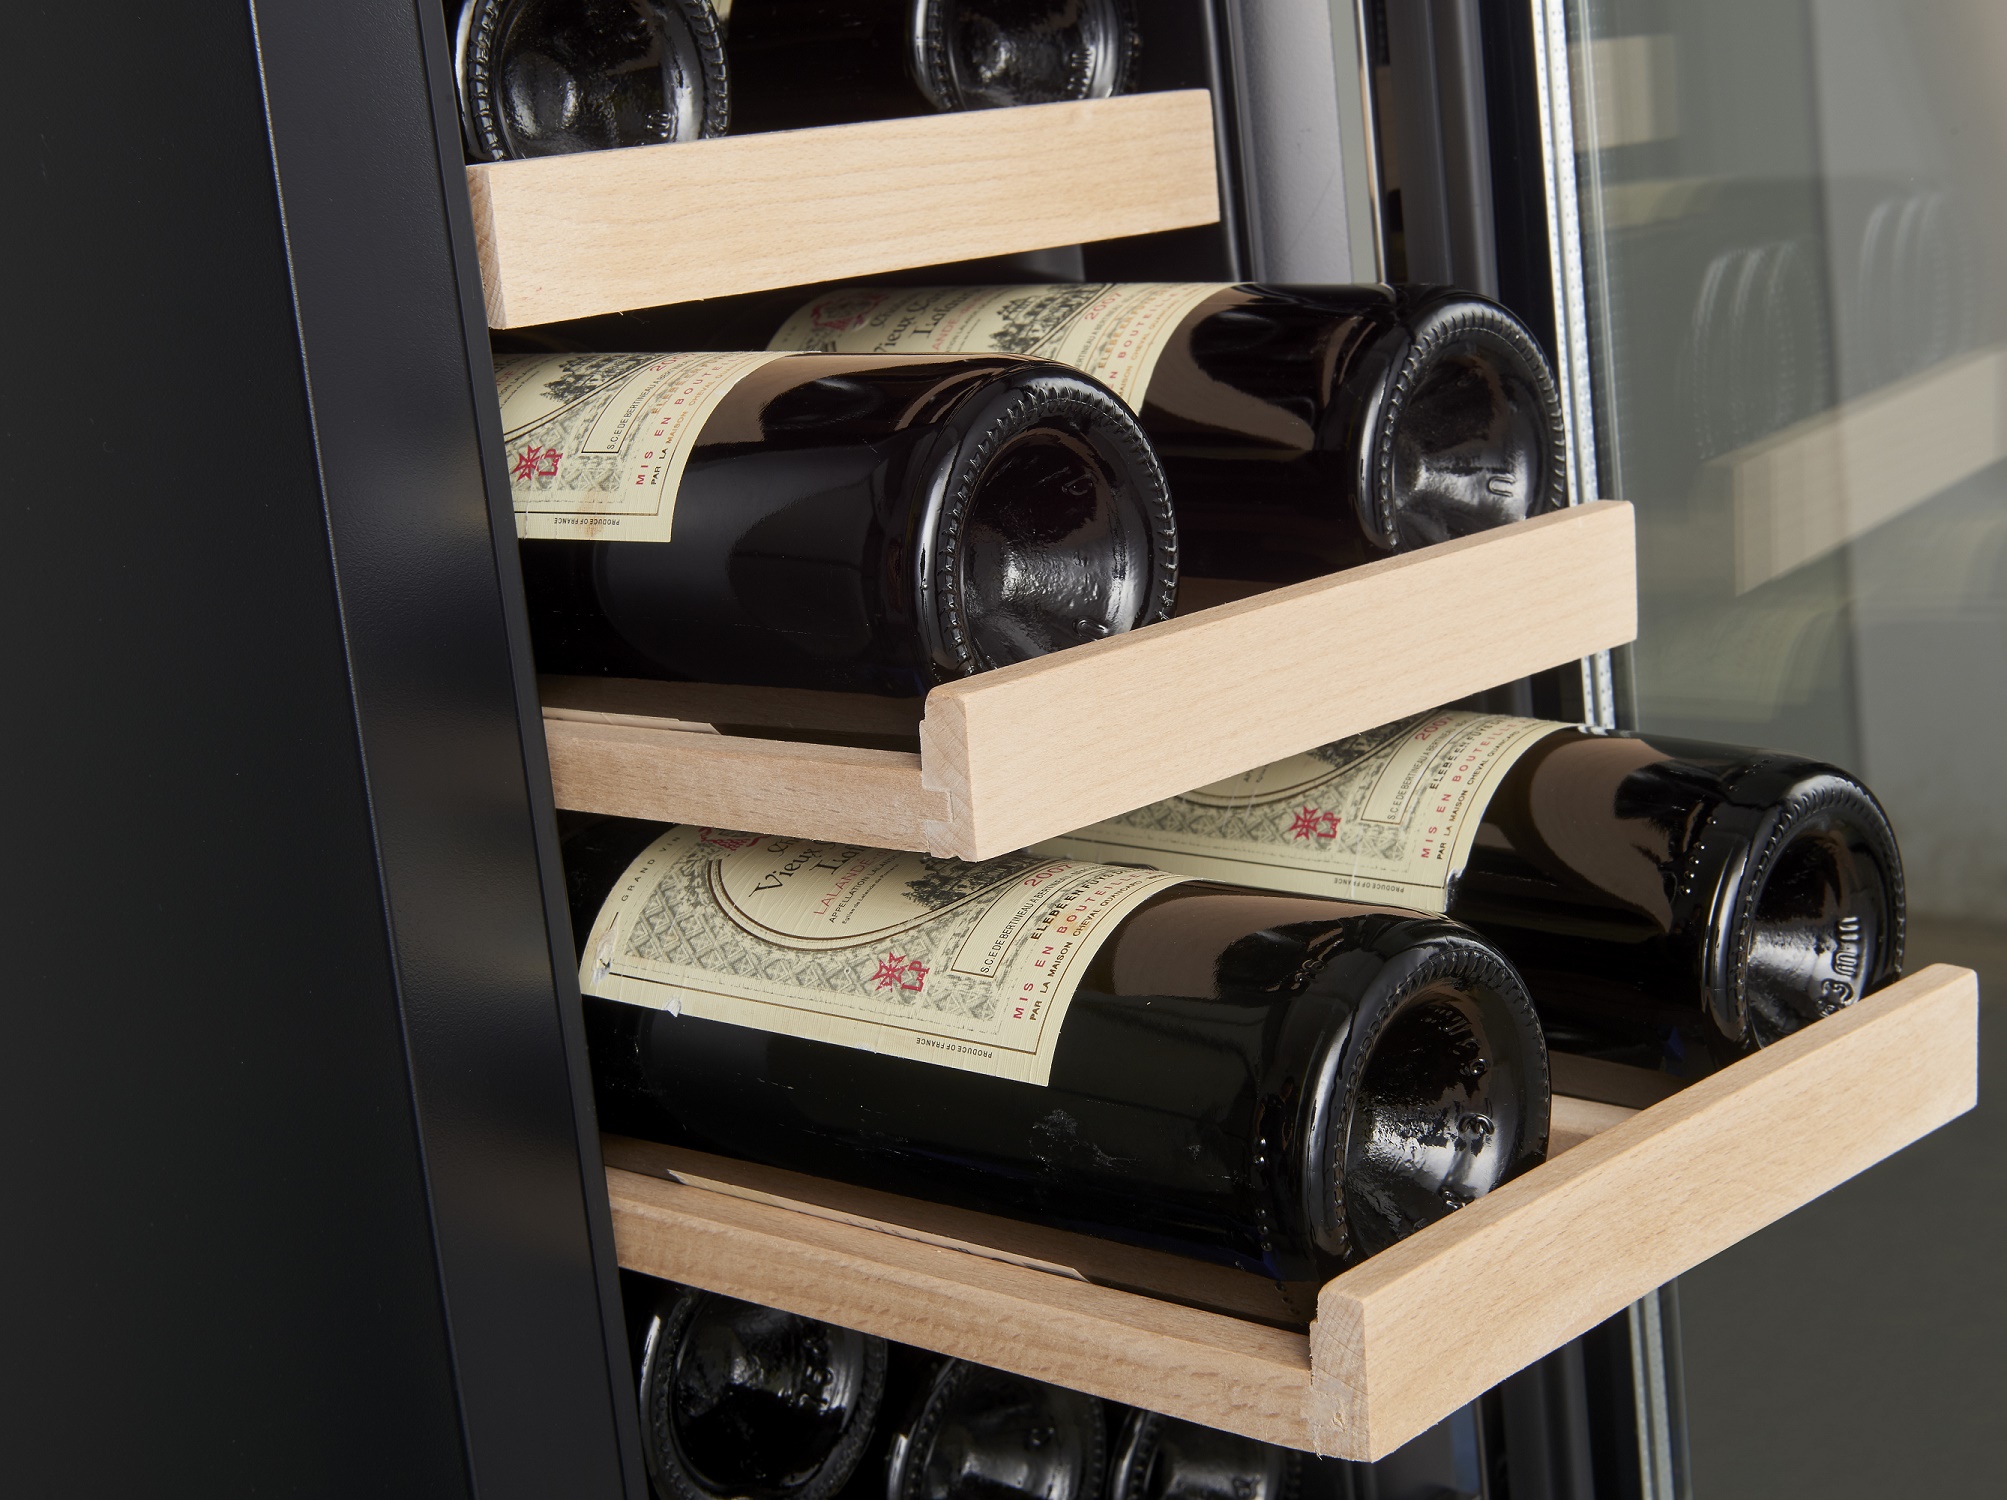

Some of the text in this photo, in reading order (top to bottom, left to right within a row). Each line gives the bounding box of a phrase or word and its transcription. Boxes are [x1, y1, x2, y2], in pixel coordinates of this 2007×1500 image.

[635, 451, 653, 485] MIS
[654, 417, 671, 436] EN
[651, 466, 661, 485] PAR
[659, 448, 668, 459] LA
[665, 411, 688, 444] MAISON
[554, 517, 579, 525] FRANCE
[1421, 826, 1437, 858] MIS
[1436, 793, 1452, 813] EN
[1452, 723, 1517, 782] BOUTEILLE
[1437, 842, 1447, 859] PAR
[1443, 826, 1452, 836] LA
[1449, 790, 1468, 822] MAISON
[1467, 759, 1489, 785] CHEVAL
[621, 836, 681, 902] GRAND VIN
[748, 848, 823, 897] Vieux
[829, 875, 869, 923] APPELLATION
[1023, 864, 1072, 887] 2007
[1372, 884, 1404, 893] PRODUCE
[1013, 982, 1034, 1019] MIS
[1034, 946, 1054, 968] EN
[1056, 873, 1141, 934] BOUTEILLE
[1029, 1000, 1042, 1021] PAR
[1040, 981, 1051, 994] LA
[1047, 941, 1073, 977] MAISON
[1072, 909, 1102, 937] CHEVAL
[916, 1038, 993, 1059] PRODUCE OF FRANCE
